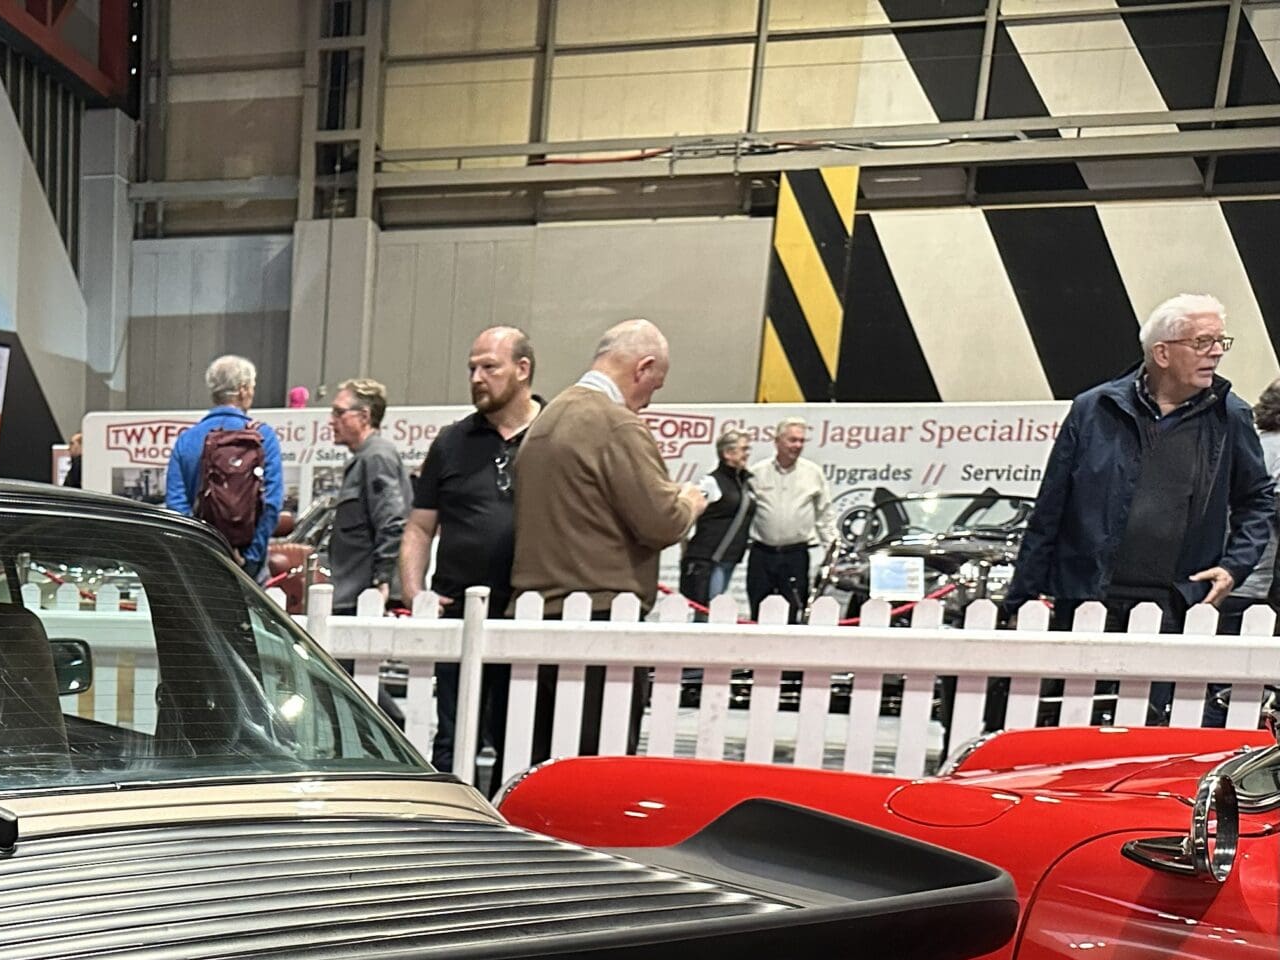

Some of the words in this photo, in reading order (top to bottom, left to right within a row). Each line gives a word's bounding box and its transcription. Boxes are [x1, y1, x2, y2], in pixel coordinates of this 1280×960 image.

[819, 419, 912, 449] Jaguar
[920, 418, 1065, 449] Specialist
[823, 463, 912, 484] Upgrades
[961, 463, 1043, 481] Servicin
